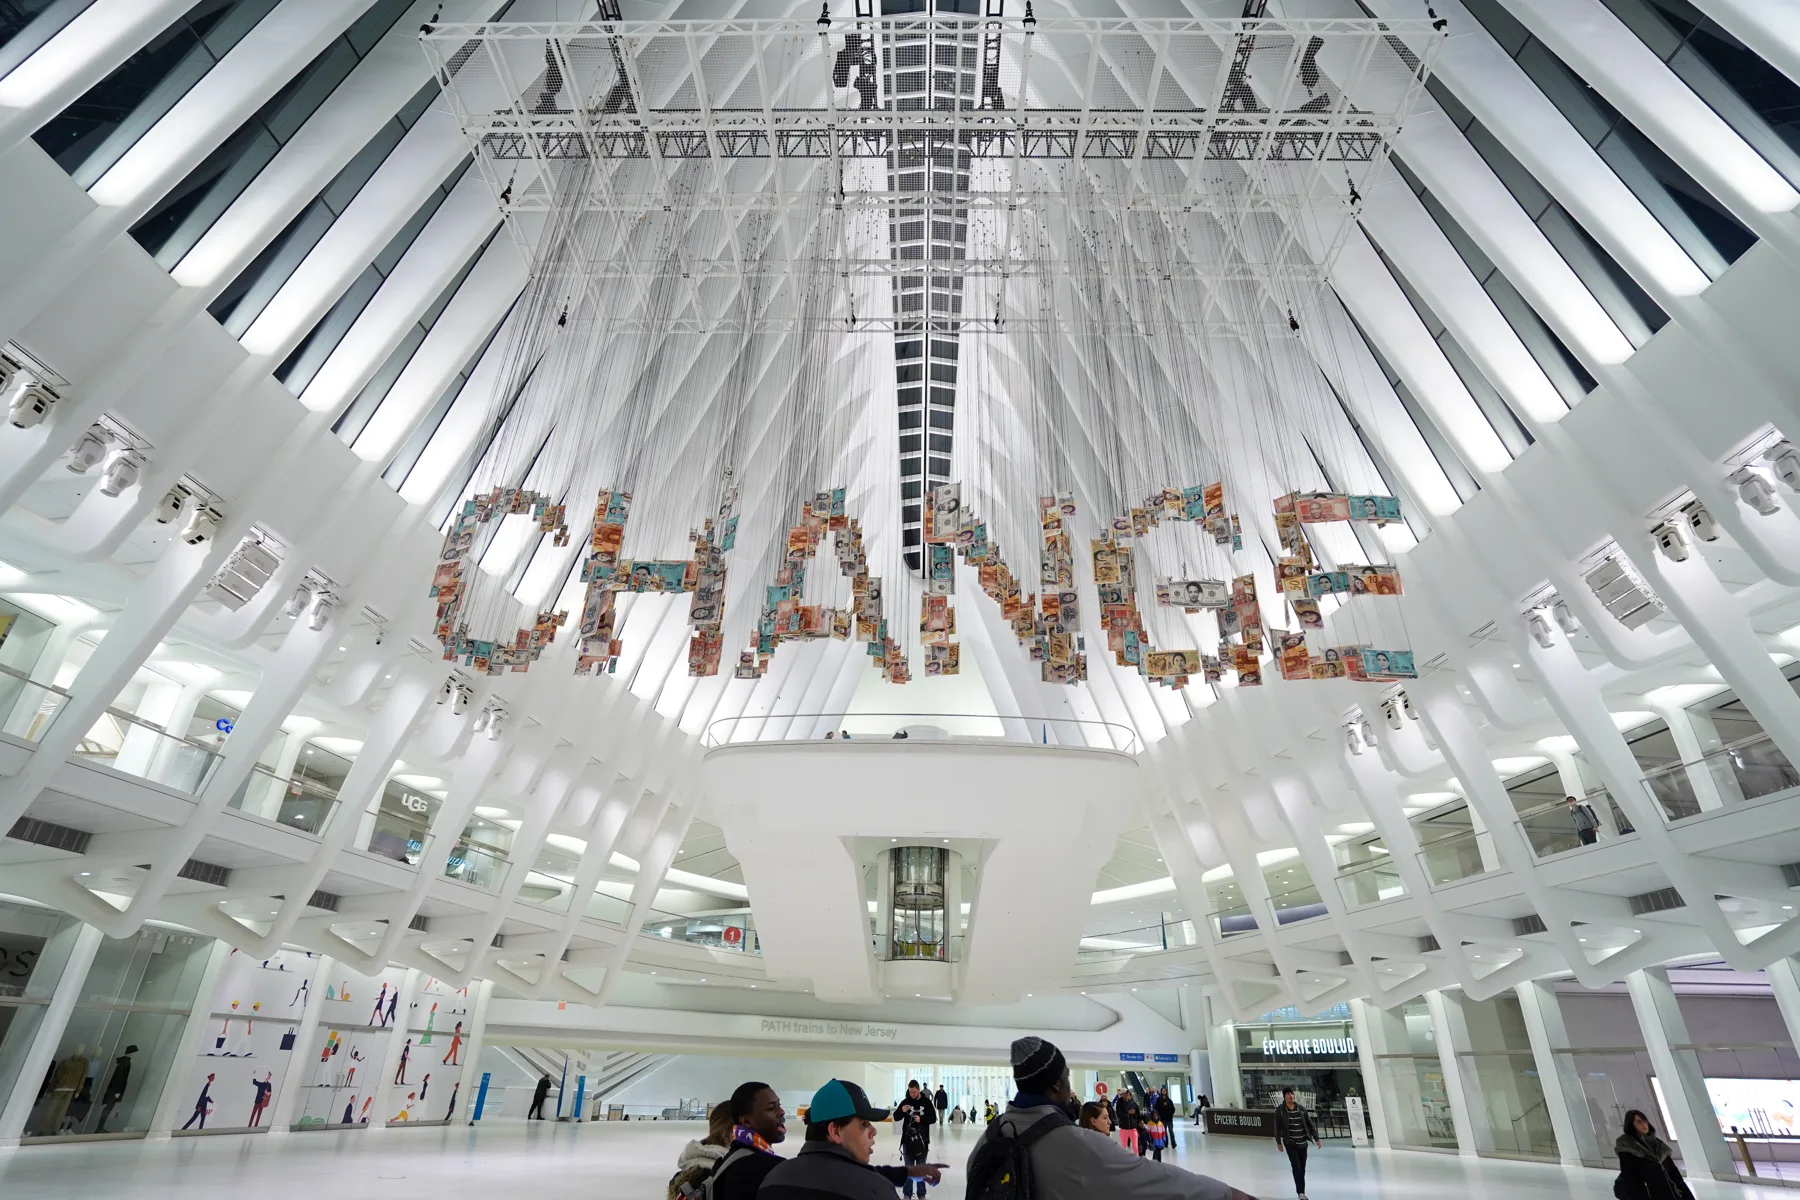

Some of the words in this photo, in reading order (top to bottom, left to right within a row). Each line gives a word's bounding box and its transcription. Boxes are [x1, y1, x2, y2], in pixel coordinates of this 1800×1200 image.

[430, 483, 1417, 689] CHANGE
[1368, 575, 1378, 584] 10
[401, 793, 428, 812] UGG
[761, 1019, 791, 1032] PATH
[794, 1022, 824, 1034] trains
[826, 1023, 837, 1035] to
[840, 1024, 862, 1036] New
[864, 1025, 897, 1039] Jersey
[1262, 1036, 1312, 1055] ÉPICERIE
[1313, 1037, 1355, 1054] BOULUD
[1214, 1113, 1238, 1126] ÉPICERIE
[1239, 1115, 1262, 1126] BOULUD
